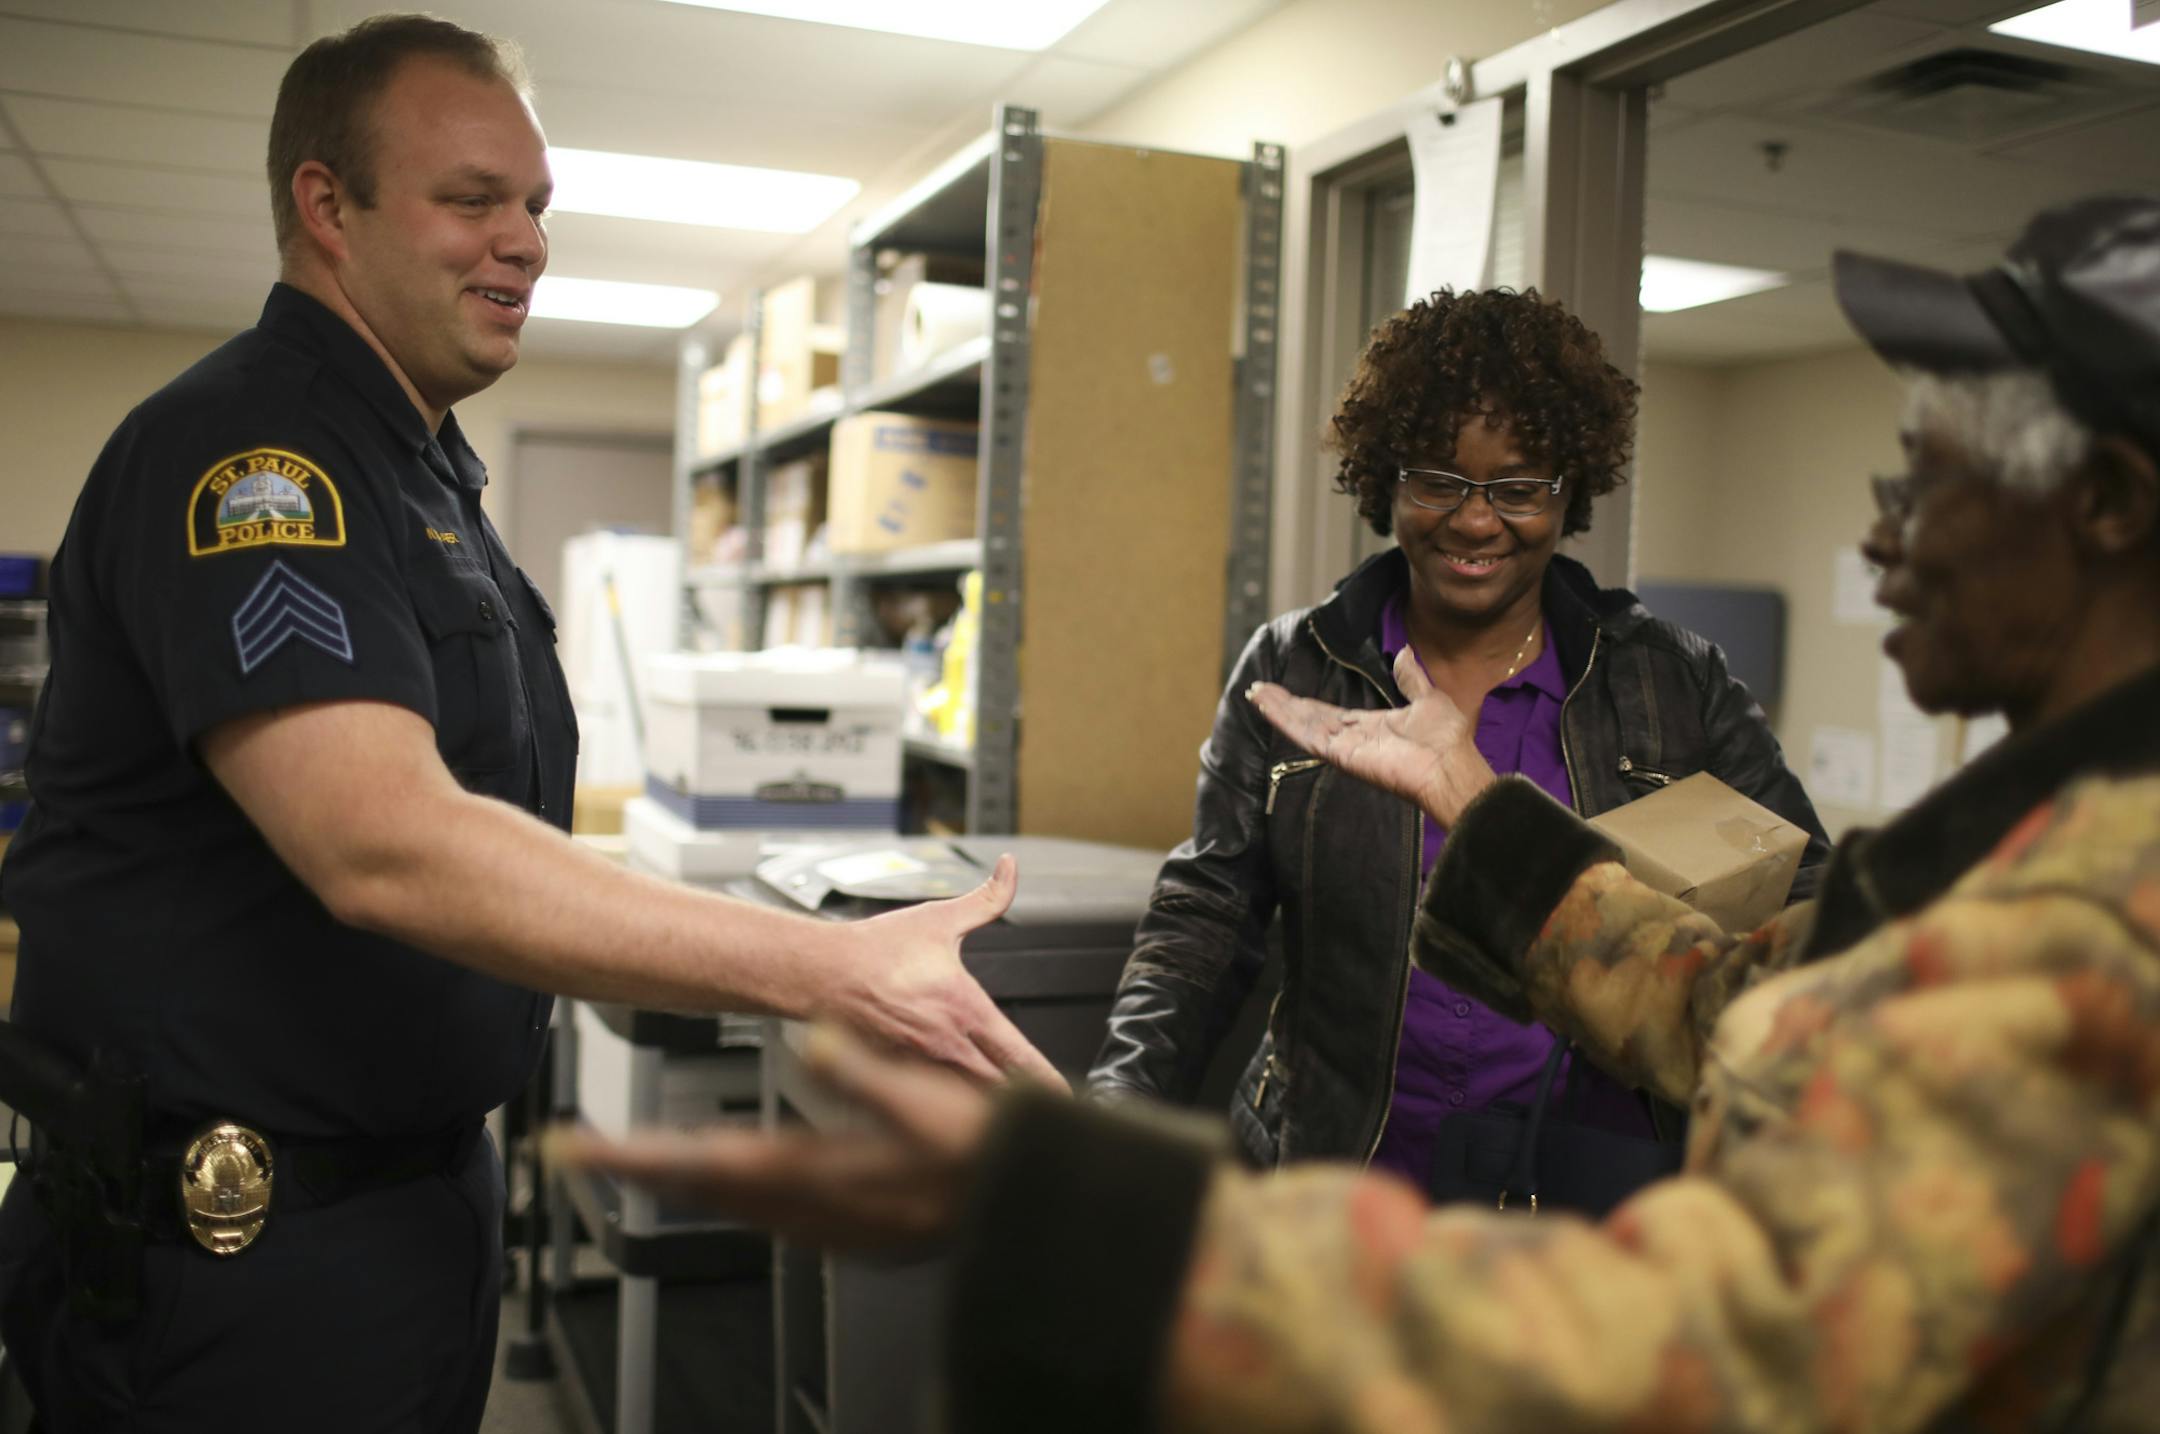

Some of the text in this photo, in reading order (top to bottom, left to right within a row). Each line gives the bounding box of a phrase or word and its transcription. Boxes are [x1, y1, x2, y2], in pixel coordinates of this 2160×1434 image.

[209, 455, 312, 496] ST. PAUL
[218, 521, 315, 546] POLICE
